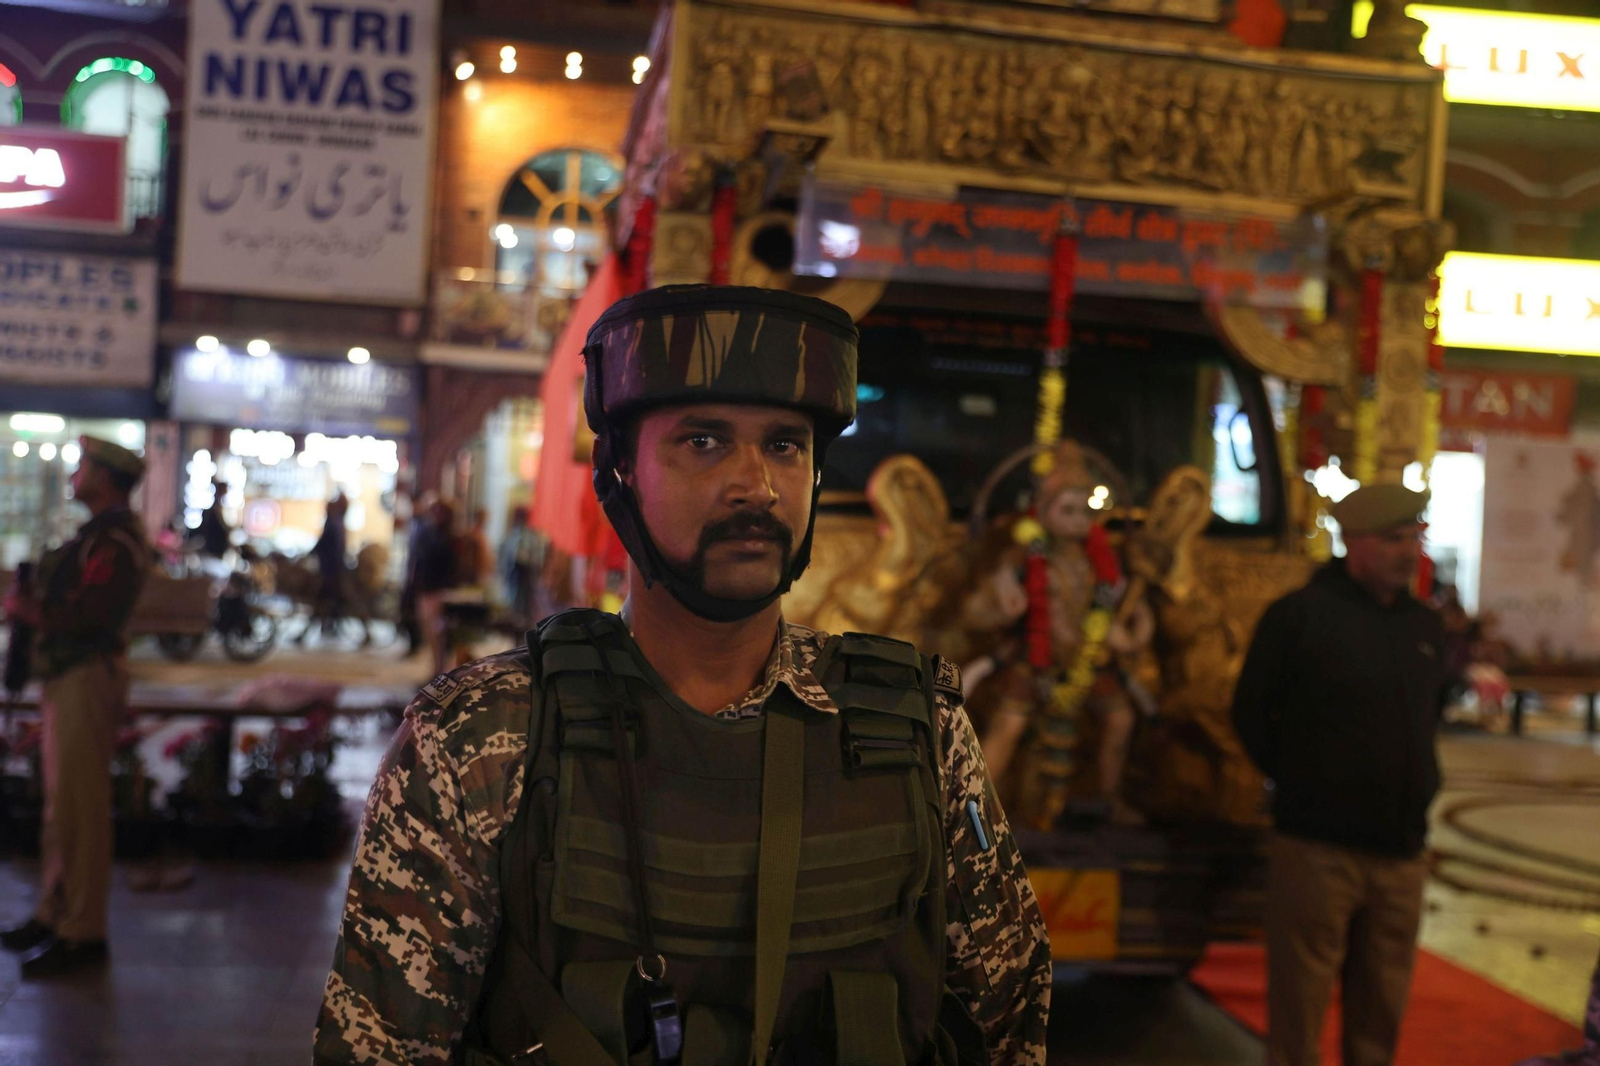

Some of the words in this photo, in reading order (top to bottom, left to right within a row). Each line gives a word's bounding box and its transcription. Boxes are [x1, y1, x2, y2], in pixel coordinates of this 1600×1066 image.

[221, 0, 411, 54] YATRI
[205, 53, 417, 114] NIWAS
[1433, 43, 1586, 79] LUX
